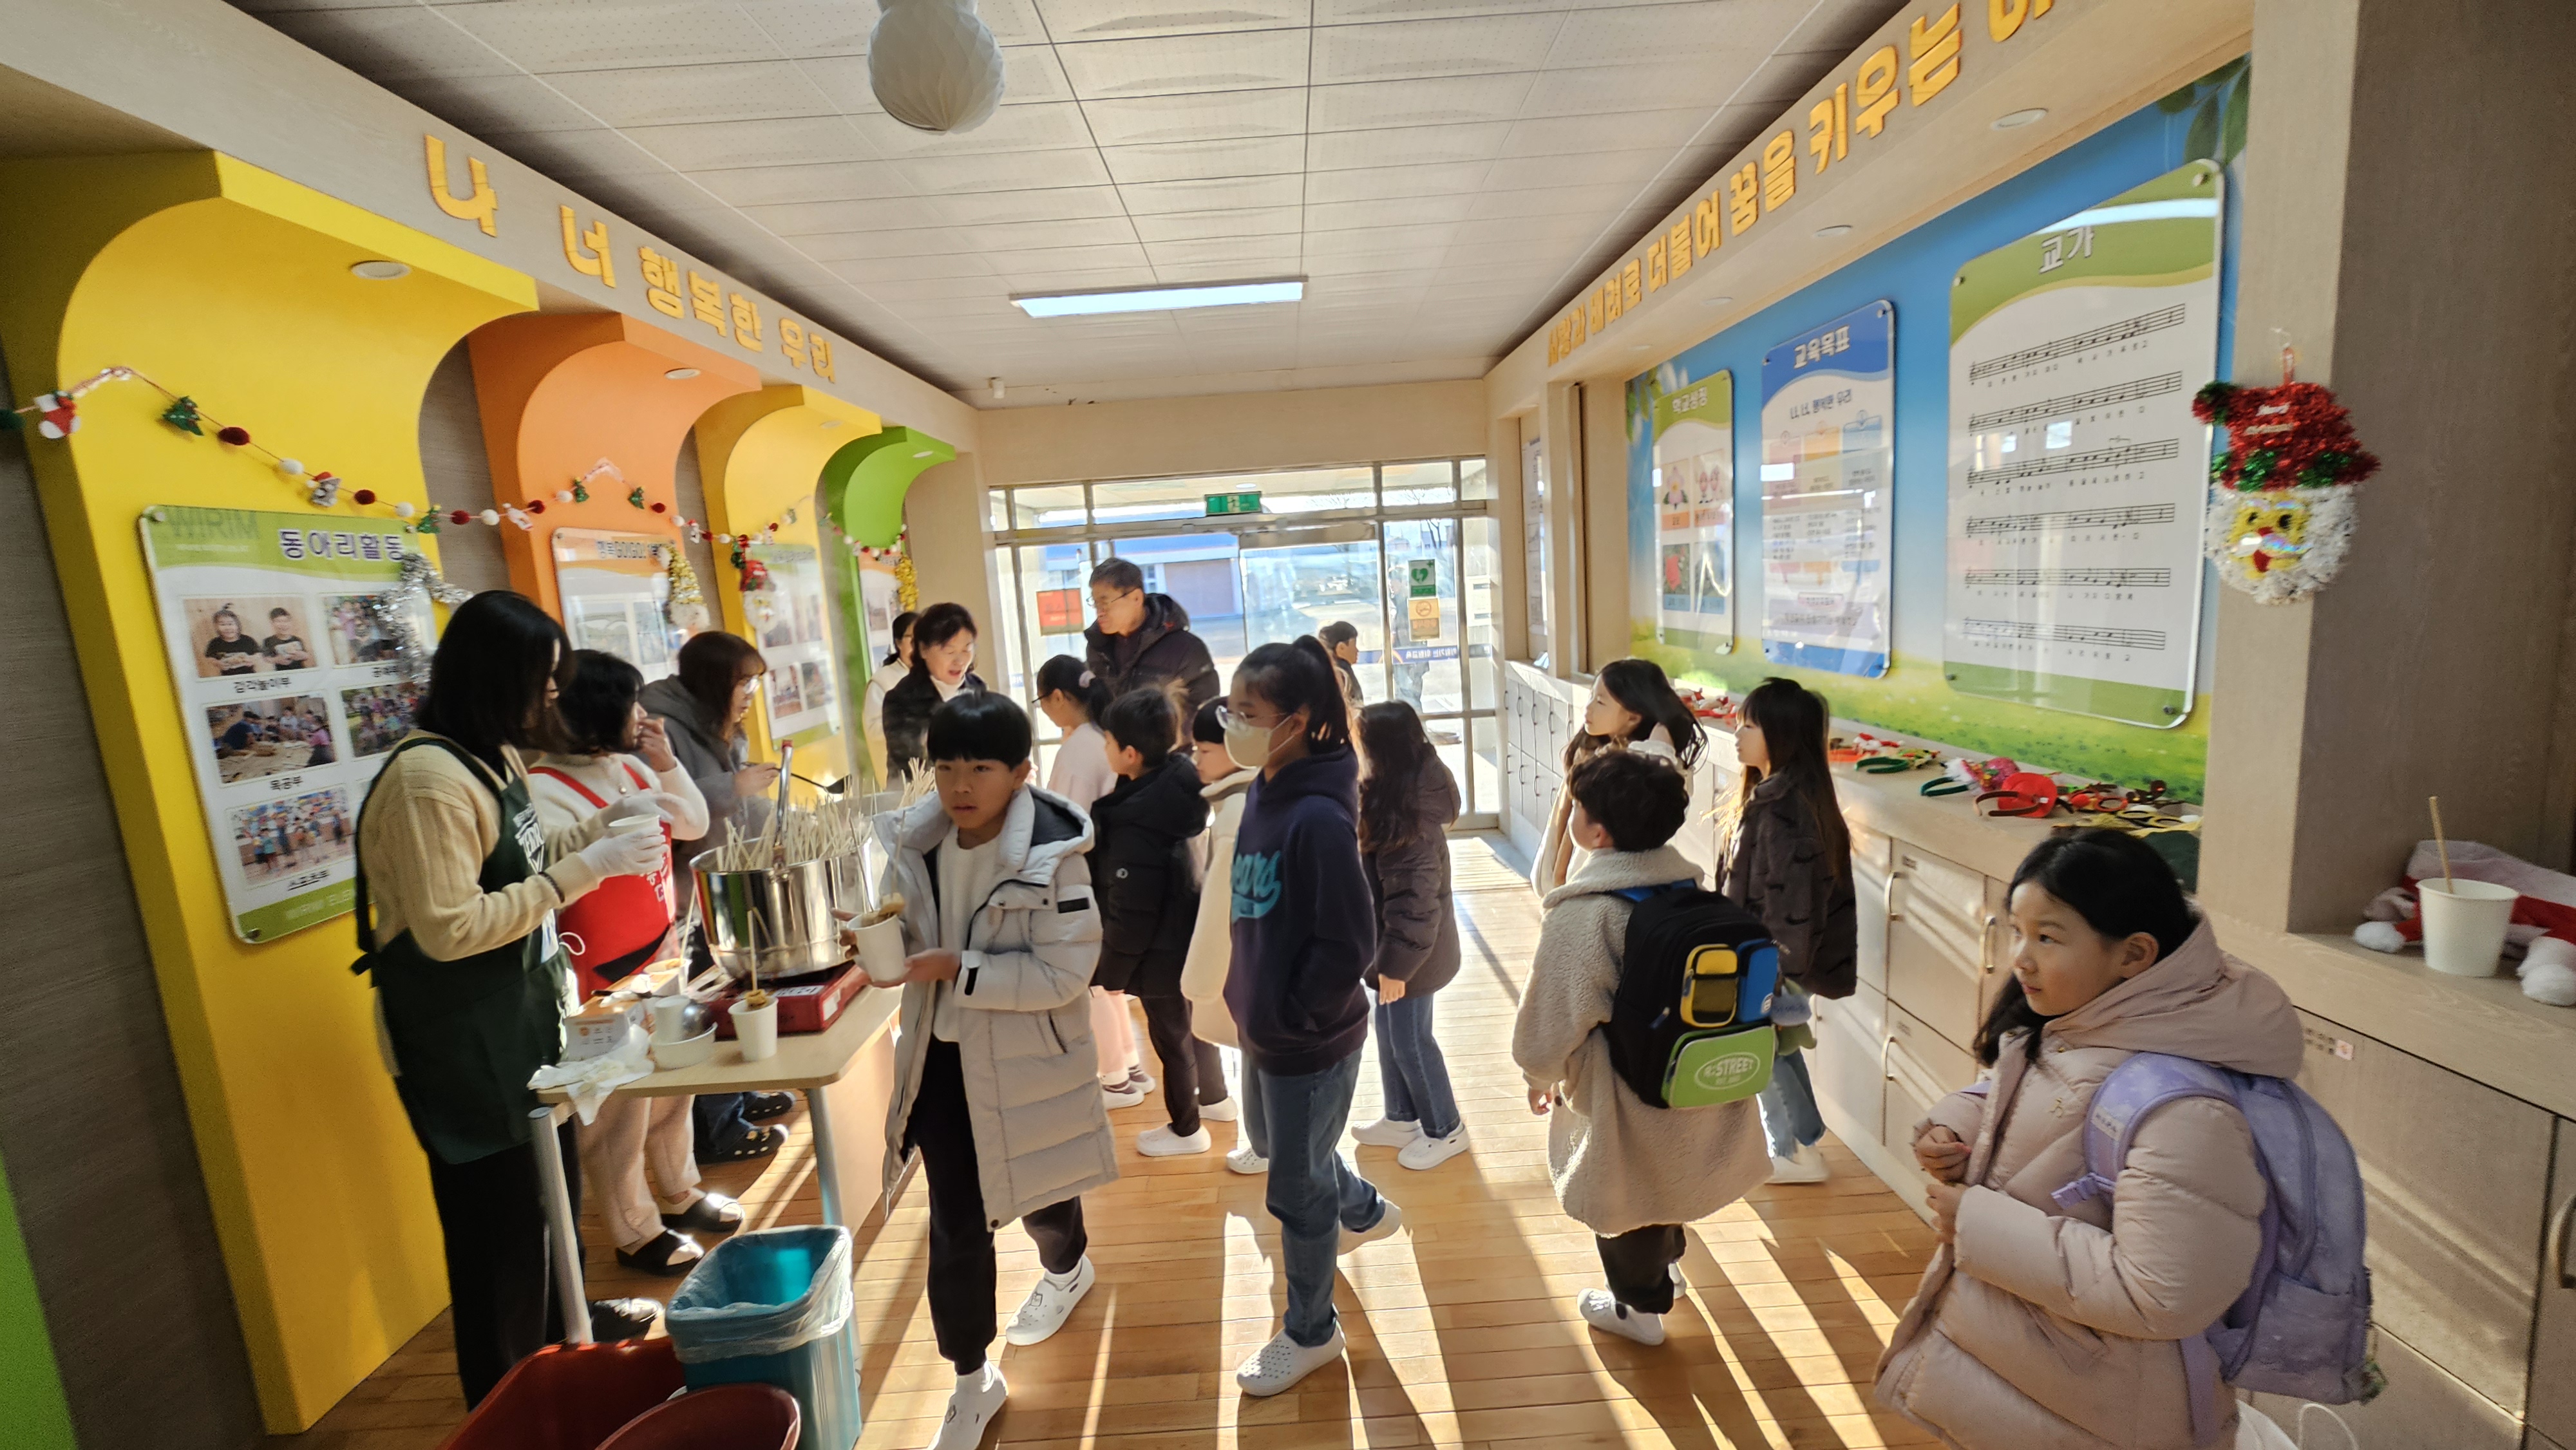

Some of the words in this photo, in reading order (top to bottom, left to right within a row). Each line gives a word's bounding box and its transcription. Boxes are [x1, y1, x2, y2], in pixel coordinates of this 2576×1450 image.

[1590, 258, 1642, 335] 배려로
[1647, 189, 1721, 292] 더불어
[1730, 129, 1796, 236] 꿈을
[1810, 3, 1962, 175] 키우는
[425, 135, 497, 238] 나
[560, 205, 616, 288] 너
[638, 246, 763, 352] 행복한
[779, 317, 835, 383] 우리
[2040, 225, 2094, 274] 교가
[1794, 325, 1850, 369] 교육목표
[279, 528, 406, 561] 동아리활동
